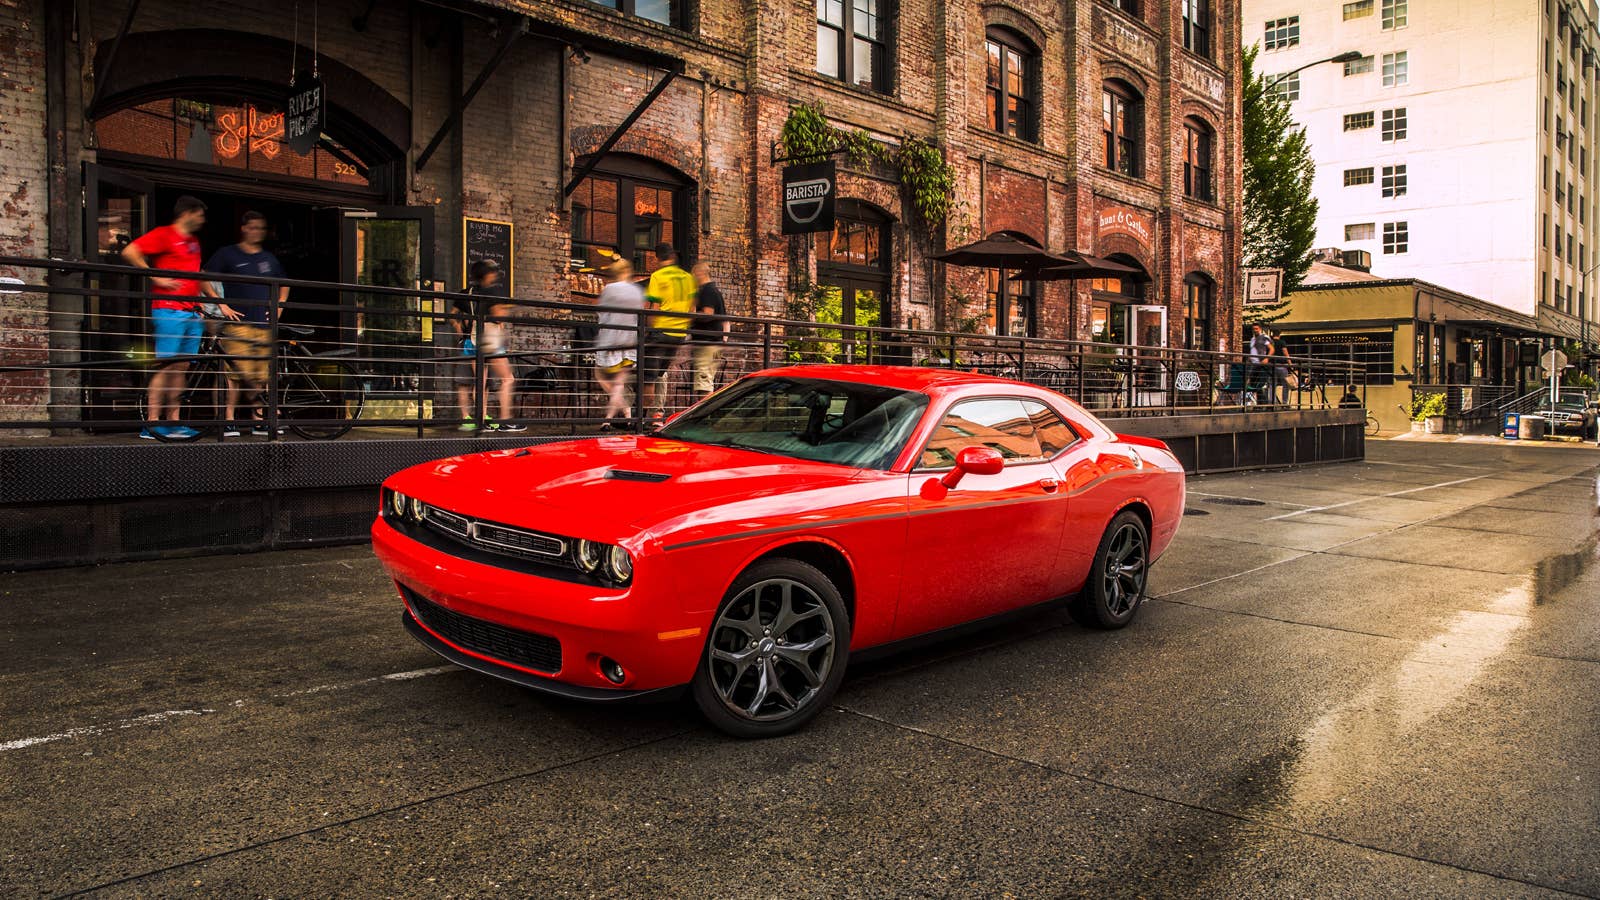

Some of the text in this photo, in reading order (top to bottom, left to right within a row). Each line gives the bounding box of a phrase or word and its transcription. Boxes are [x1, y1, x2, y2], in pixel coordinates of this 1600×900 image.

[289, 87, 320, 117] RIVER
[335, 162, 357, 176] 529
[786, 184, 825, 200] BARISTA
[1100, 215, 1116, 227] hunt
[1126, 213, 1149, 240] Gather
